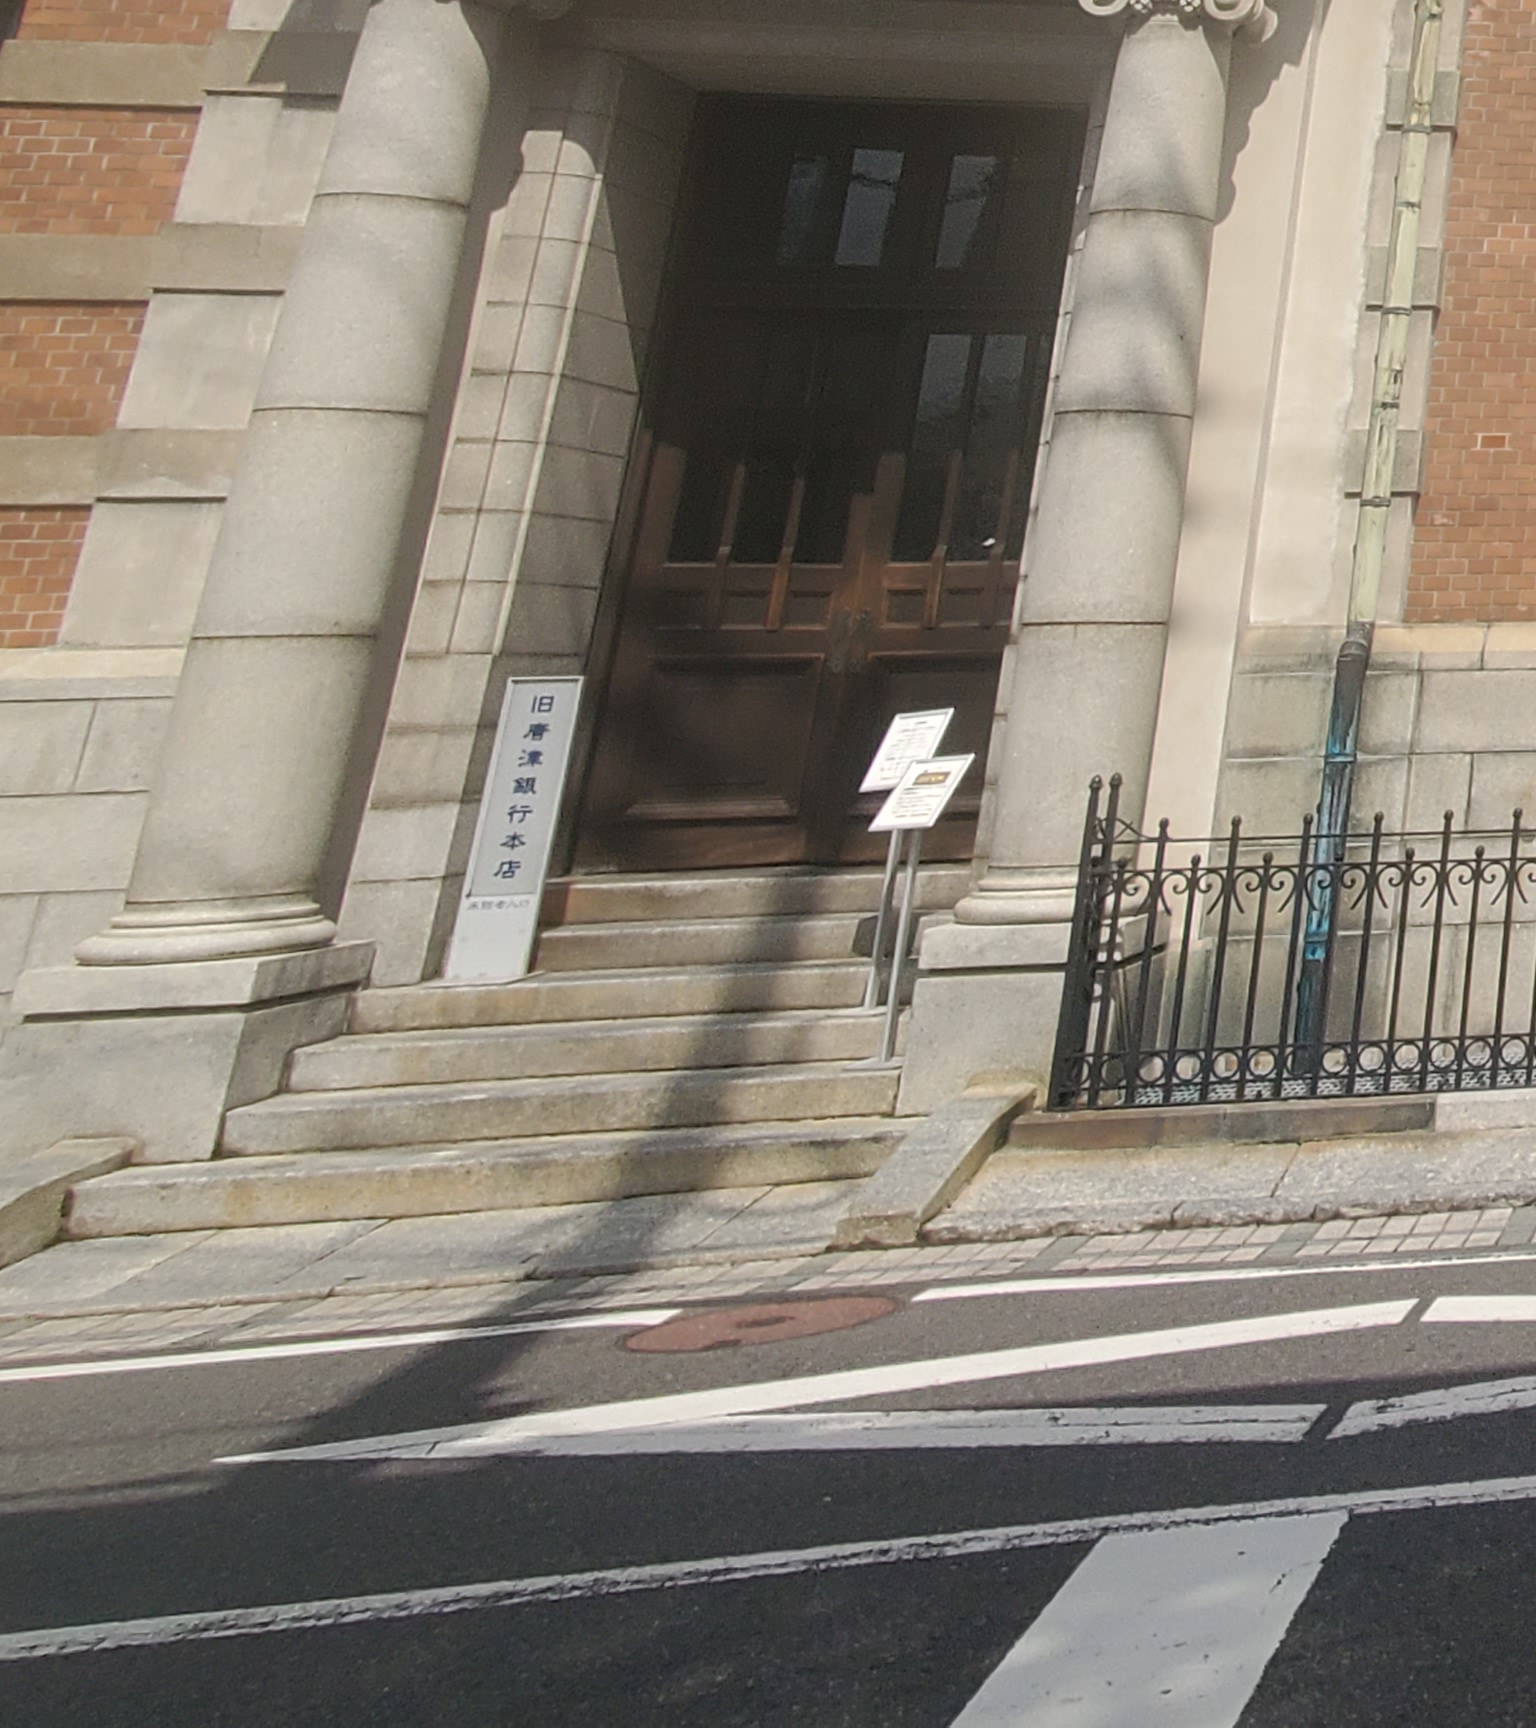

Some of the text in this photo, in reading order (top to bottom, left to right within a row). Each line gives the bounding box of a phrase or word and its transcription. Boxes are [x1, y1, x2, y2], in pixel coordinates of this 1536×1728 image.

[493, 695, 555, 880] 旧唐津銀行本店
